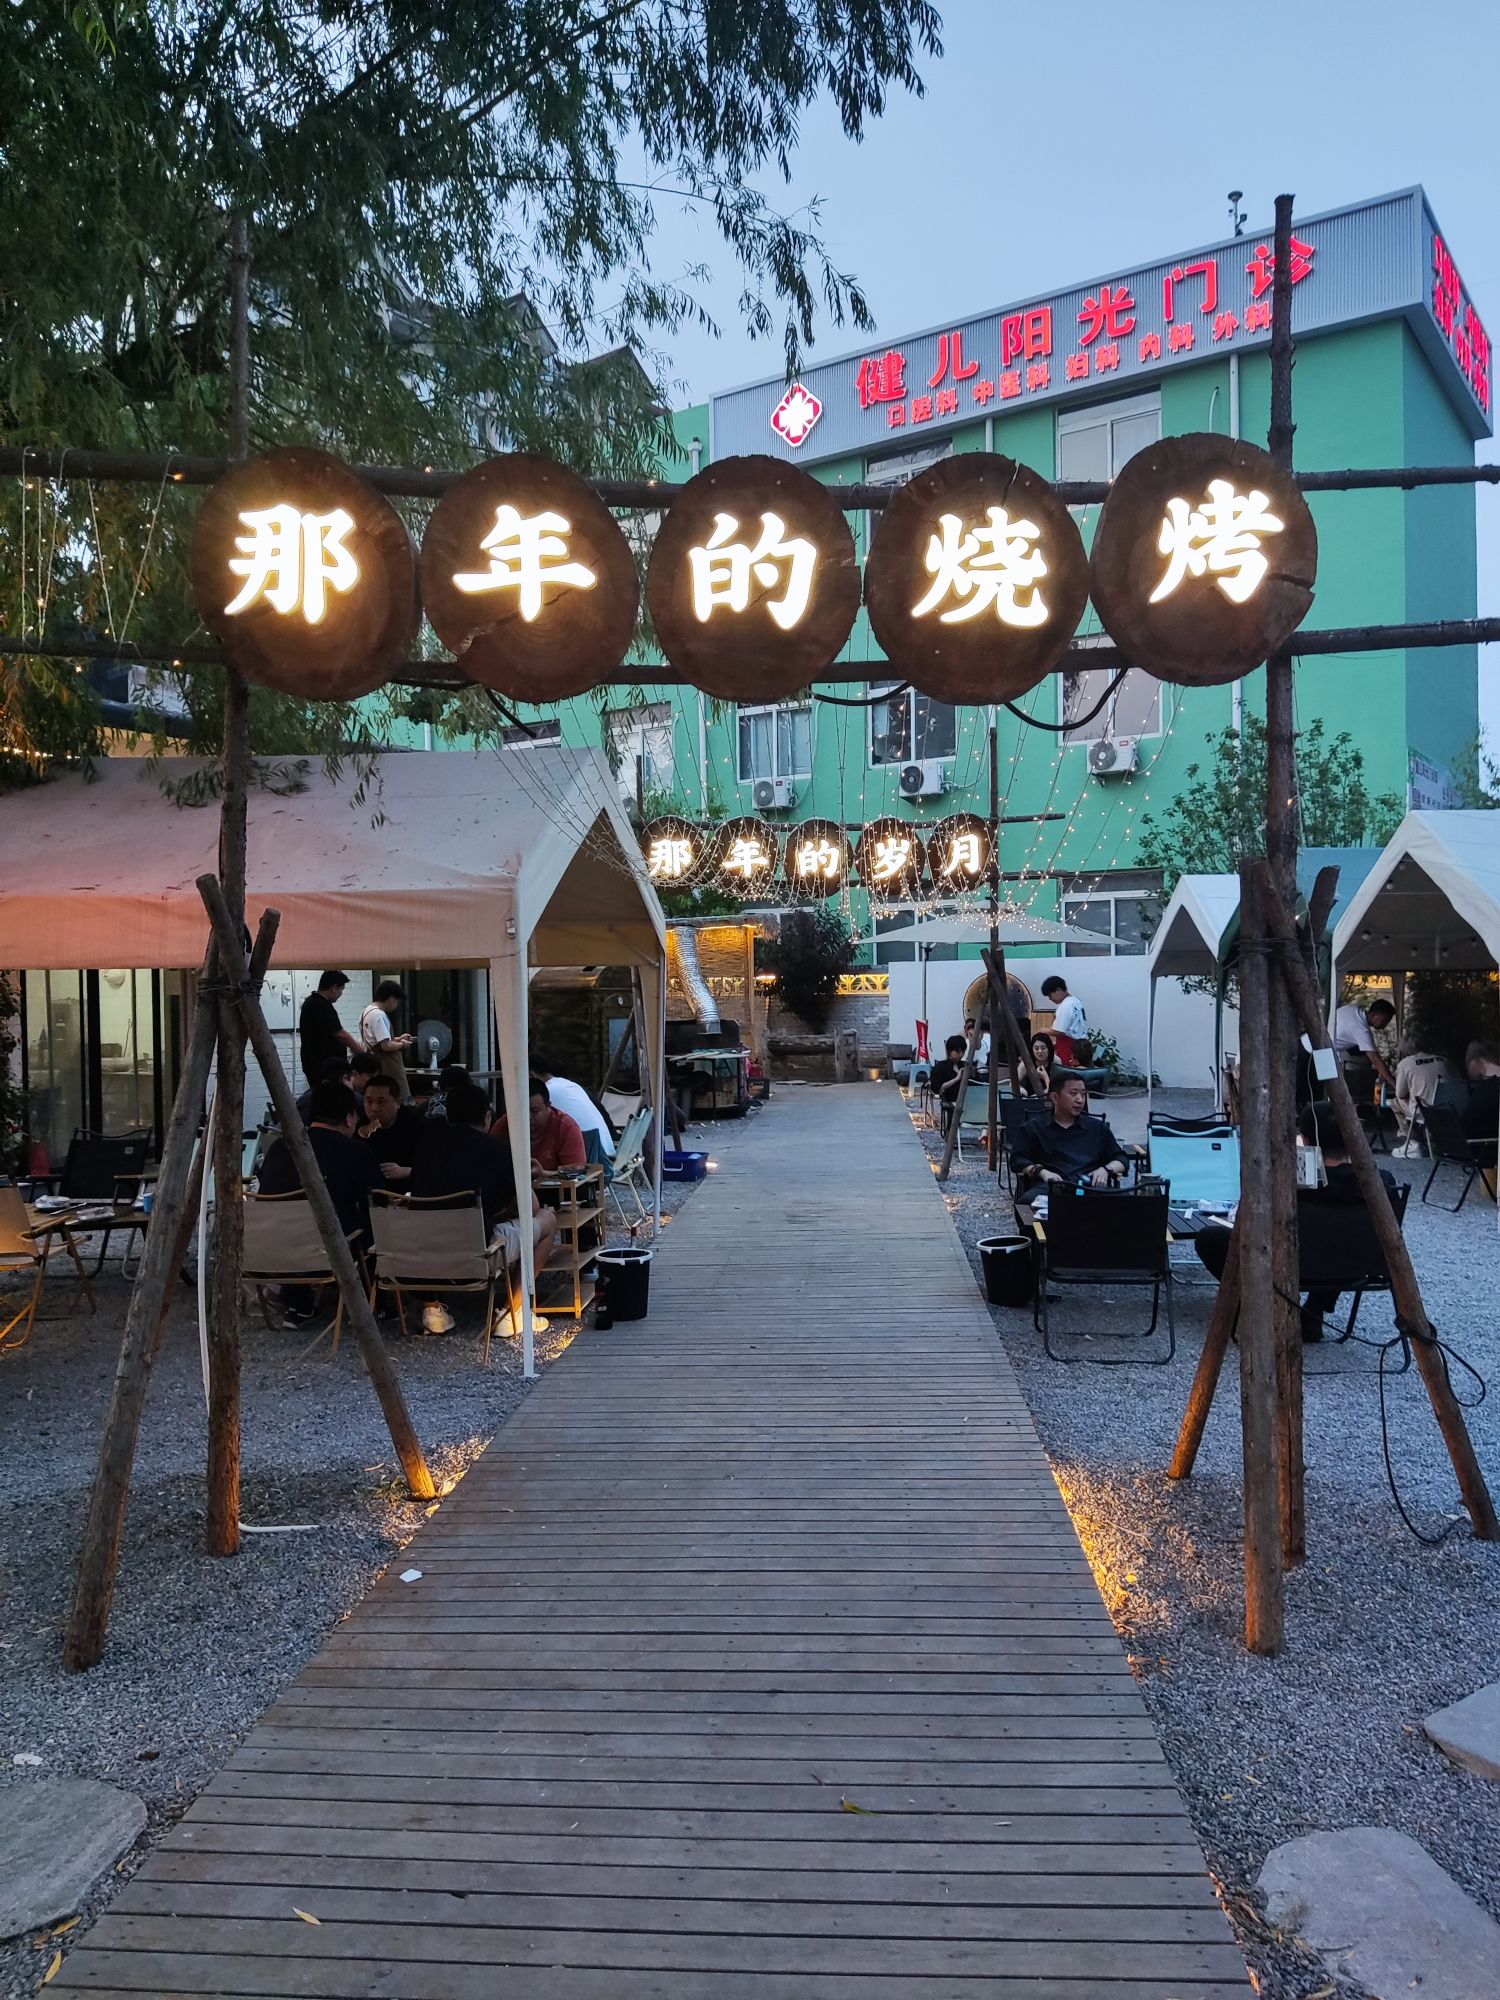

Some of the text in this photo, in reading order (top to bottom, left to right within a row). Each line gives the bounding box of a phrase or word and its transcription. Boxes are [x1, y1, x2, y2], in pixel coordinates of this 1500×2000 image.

[855, 235, 1315, 409] 健儿阳光门诊
[886, 300, 1273, 429] 口腔科 中医科 妇科 内科 外科
[224, 479, 1285, 631] 那年的烧烤
[649, 833, 980, 880] 那年的岁月
